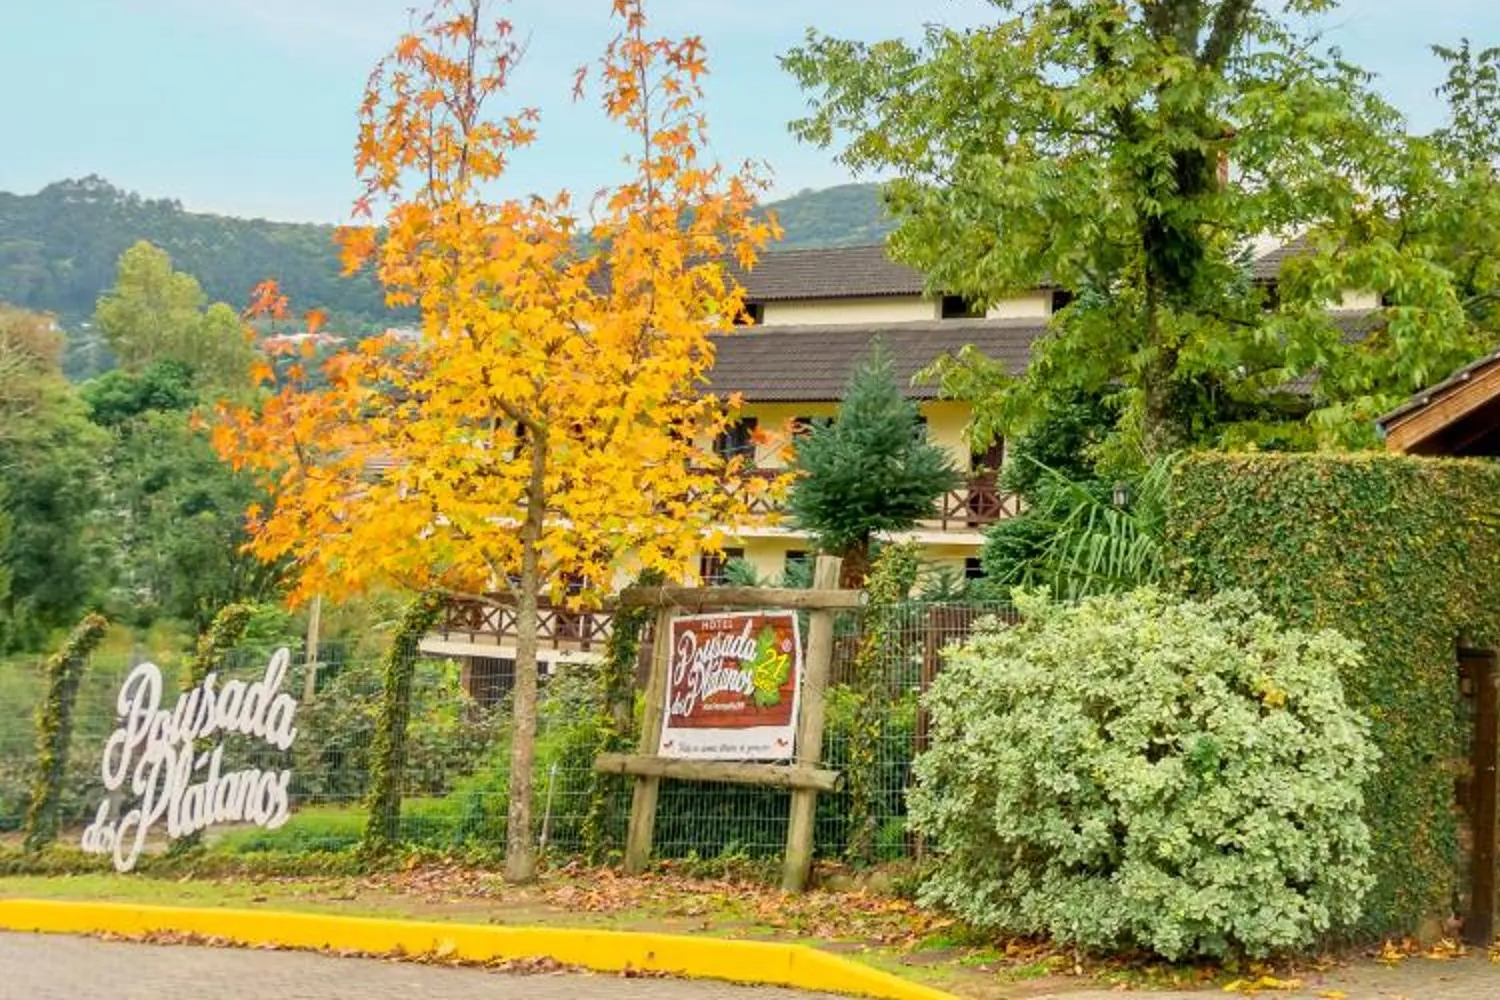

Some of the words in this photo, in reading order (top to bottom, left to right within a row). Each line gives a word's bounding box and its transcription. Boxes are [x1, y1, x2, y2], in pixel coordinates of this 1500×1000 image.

[674, 618, 758, 686] Pousada
[701, 618, 734, 631] HOTEL
[103, 647, 298, 790] Pousada
[82, 799, 116, 854] dos
[114, 739, 290, 872] Plátanos
